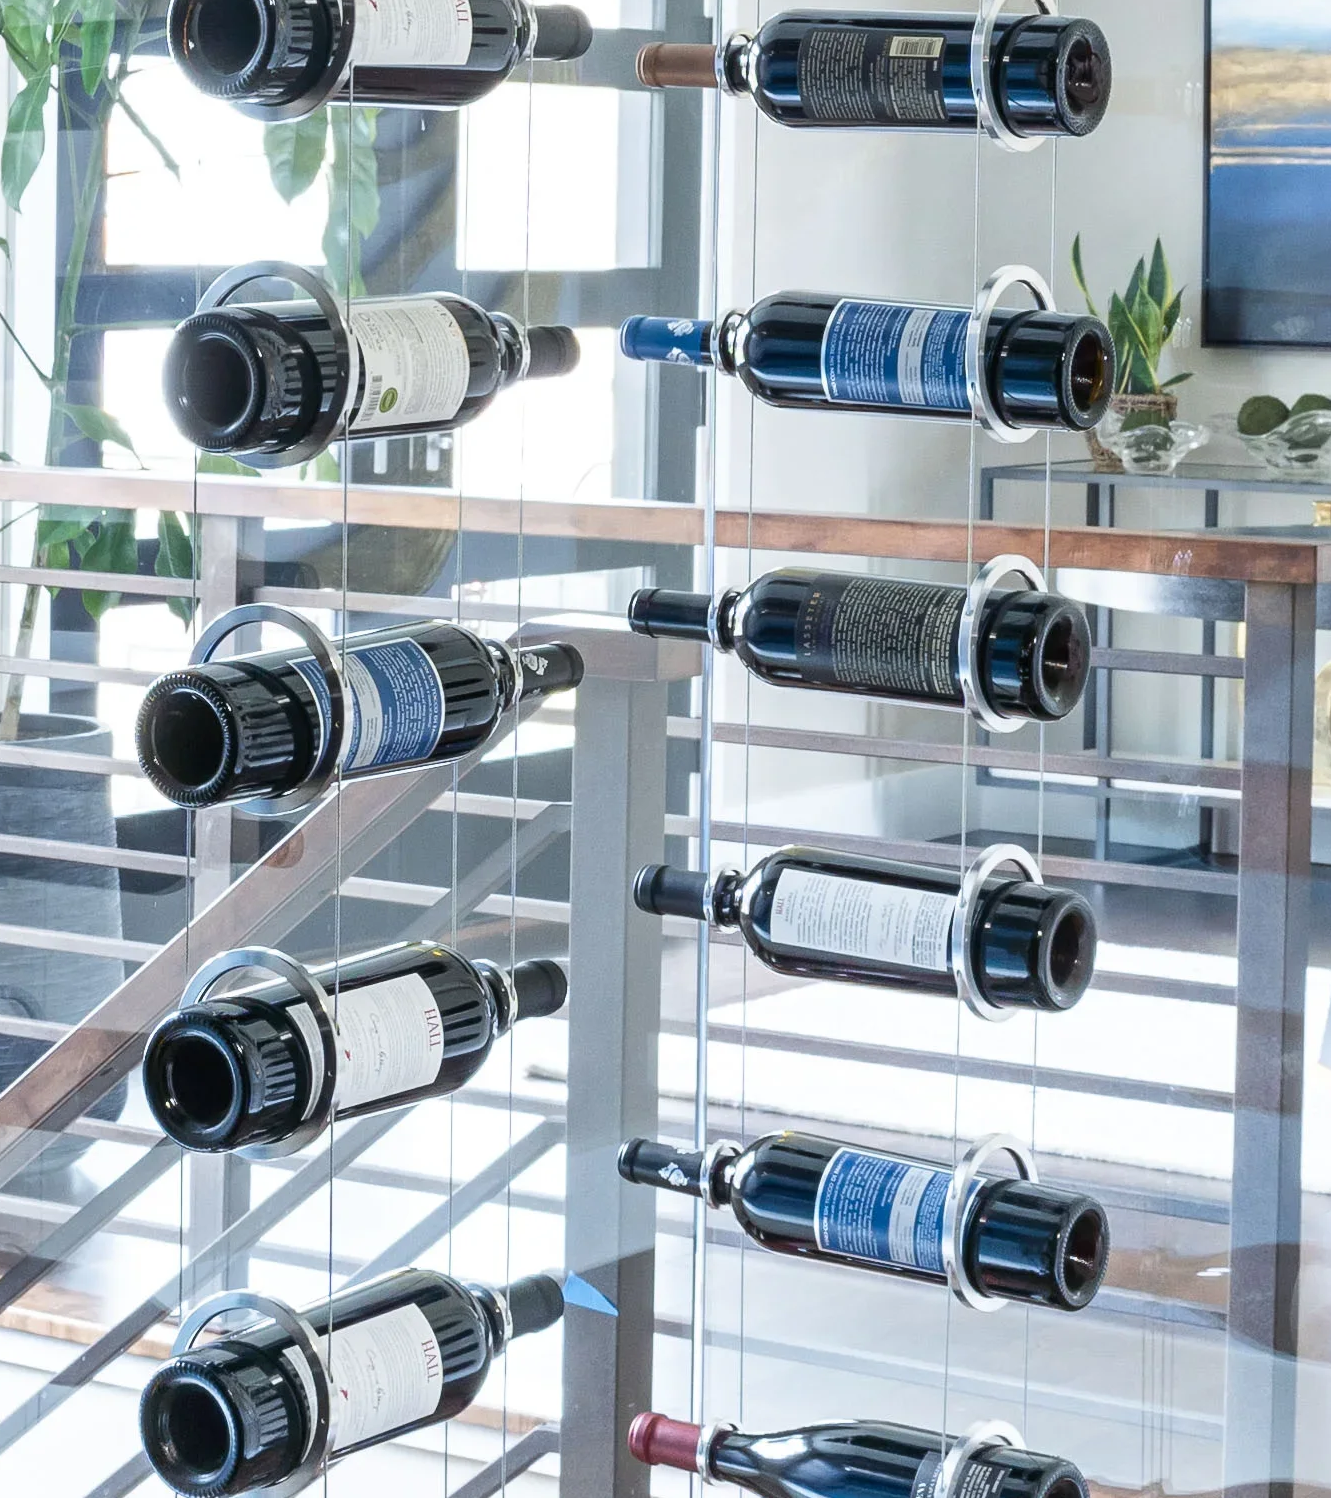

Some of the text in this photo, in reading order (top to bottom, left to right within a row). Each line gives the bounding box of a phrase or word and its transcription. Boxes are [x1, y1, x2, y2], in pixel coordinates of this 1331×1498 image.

[830, 356, 835, 366] UN
[804, 592, 821, 656] LASSETER
[424, 1009, 441, 1051] HALL
[825, 1183, 833, 1203] TOCCO
[421, 1339, 439, 1384] HALL
